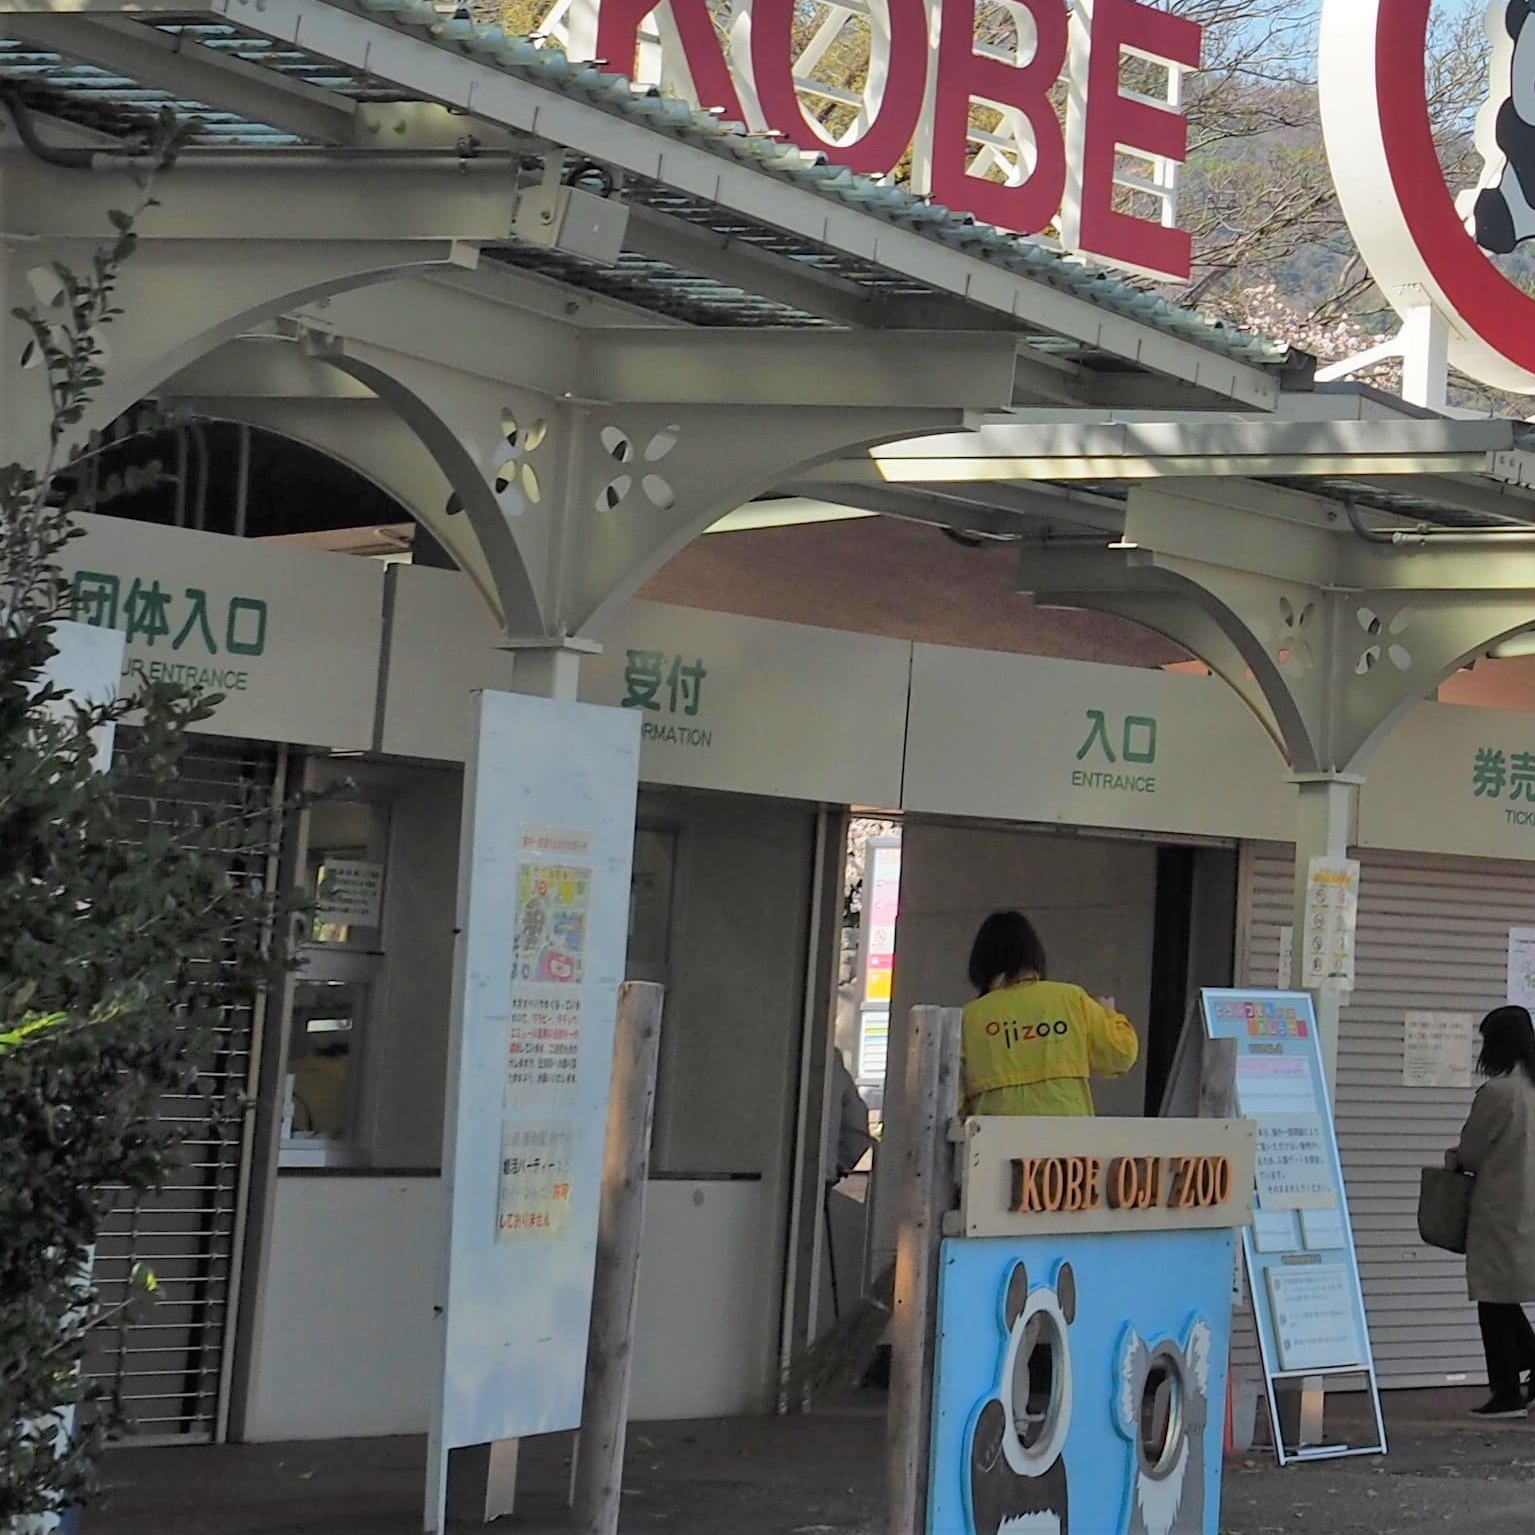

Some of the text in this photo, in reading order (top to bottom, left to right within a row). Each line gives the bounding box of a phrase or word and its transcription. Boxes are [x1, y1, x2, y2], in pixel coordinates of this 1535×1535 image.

[70, 570, 268, 657] 団体入口
[150, 661, 249, 691] ENTRANCE
[621, 649, 707, 717] 受付
[641, 722, 712, 747] RMATION
[1076, 709, 1157, 764] 入口
[1072, 770, 1156, 793] ENTRANCE
[985, 1019, 1068, 1050] ojizoo
[1010, 1155, 1233, 1213] KOBE OJI ZOO
